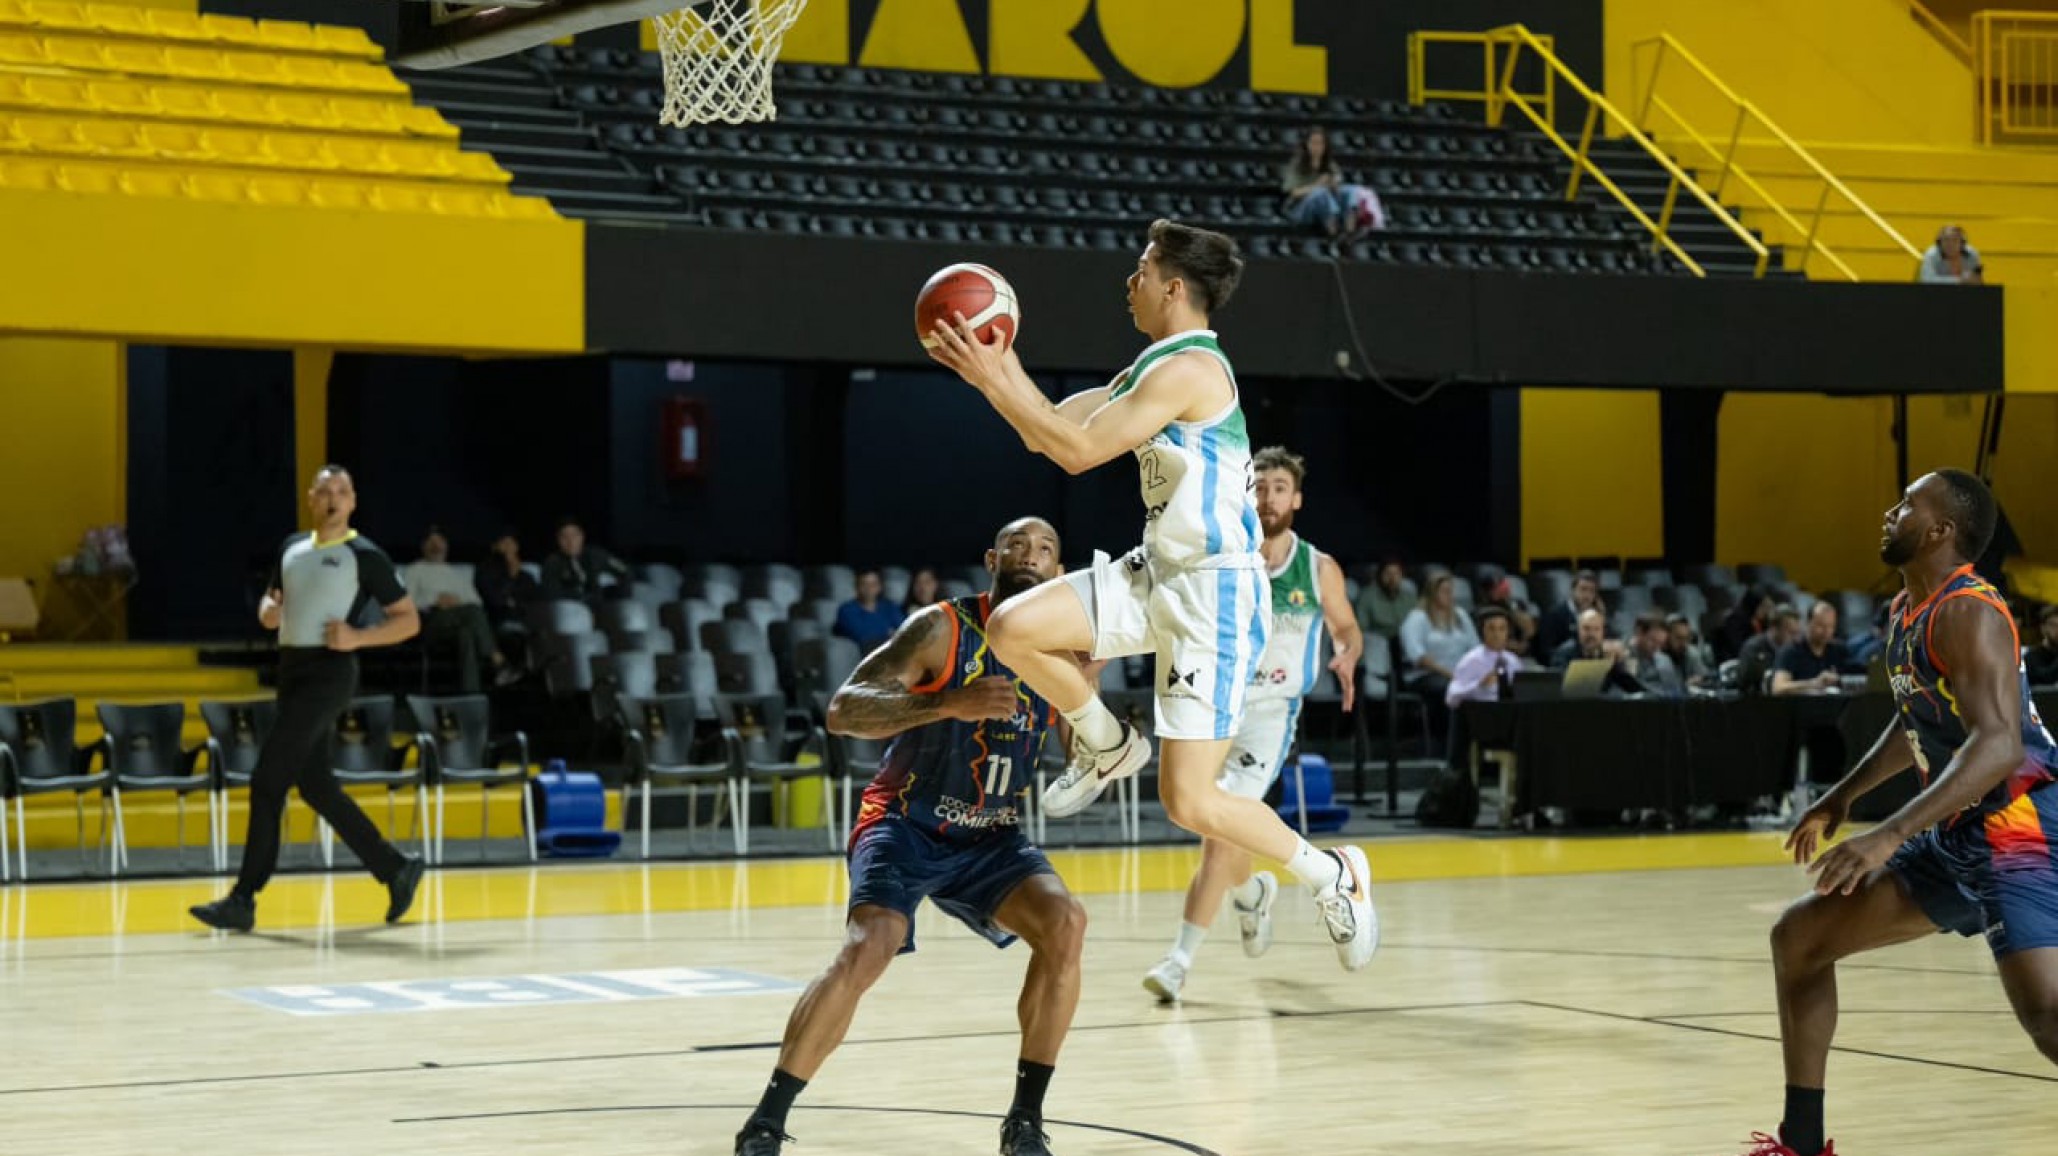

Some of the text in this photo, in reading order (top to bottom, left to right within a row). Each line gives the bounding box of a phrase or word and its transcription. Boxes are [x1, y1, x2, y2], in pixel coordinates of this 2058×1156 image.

[553, 0, 1328, 95] AROL
[1140, 449, 1167, 489] 2
[985, 754, 1013, 796] 11
